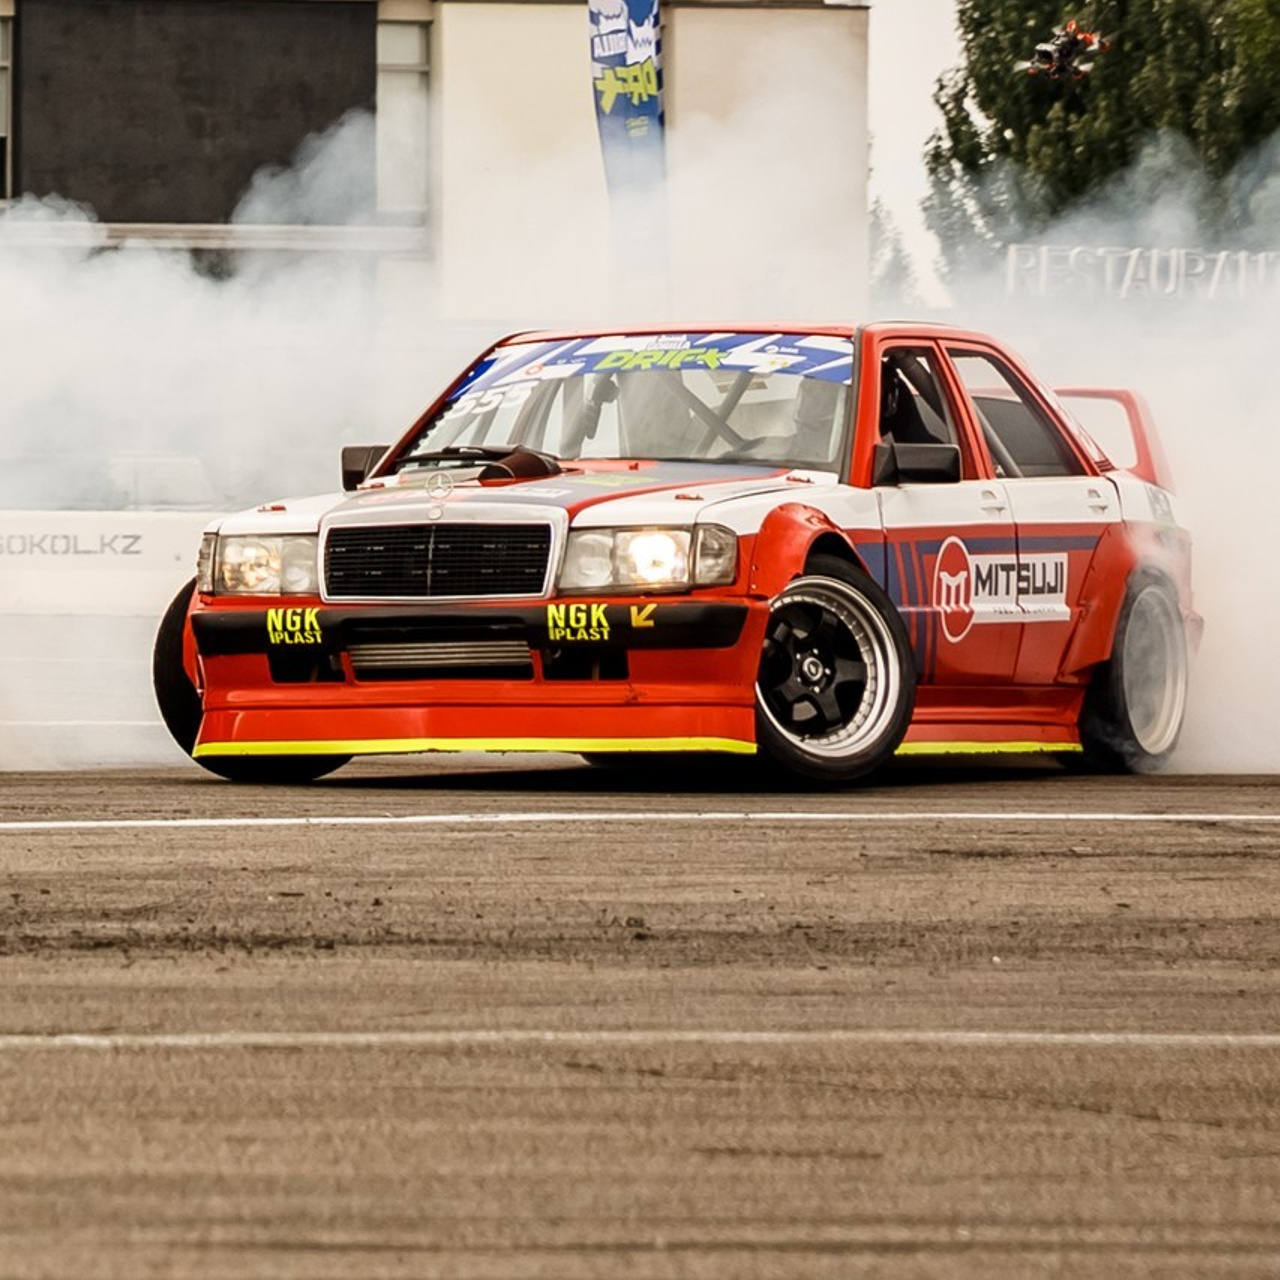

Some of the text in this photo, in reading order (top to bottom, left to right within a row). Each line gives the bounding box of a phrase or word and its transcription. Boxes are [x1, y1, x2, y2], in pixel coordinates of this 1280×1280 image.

[593, 347, 729, 371] DRIFT
[974, 561, 1064, 597] MITSUJI
[267, 607, 321, 632] NGK
[547, 603, 609, 629] NGK
[274, 630, 322, 644] PLAST
[554, 627, 611, 641] PLAST
